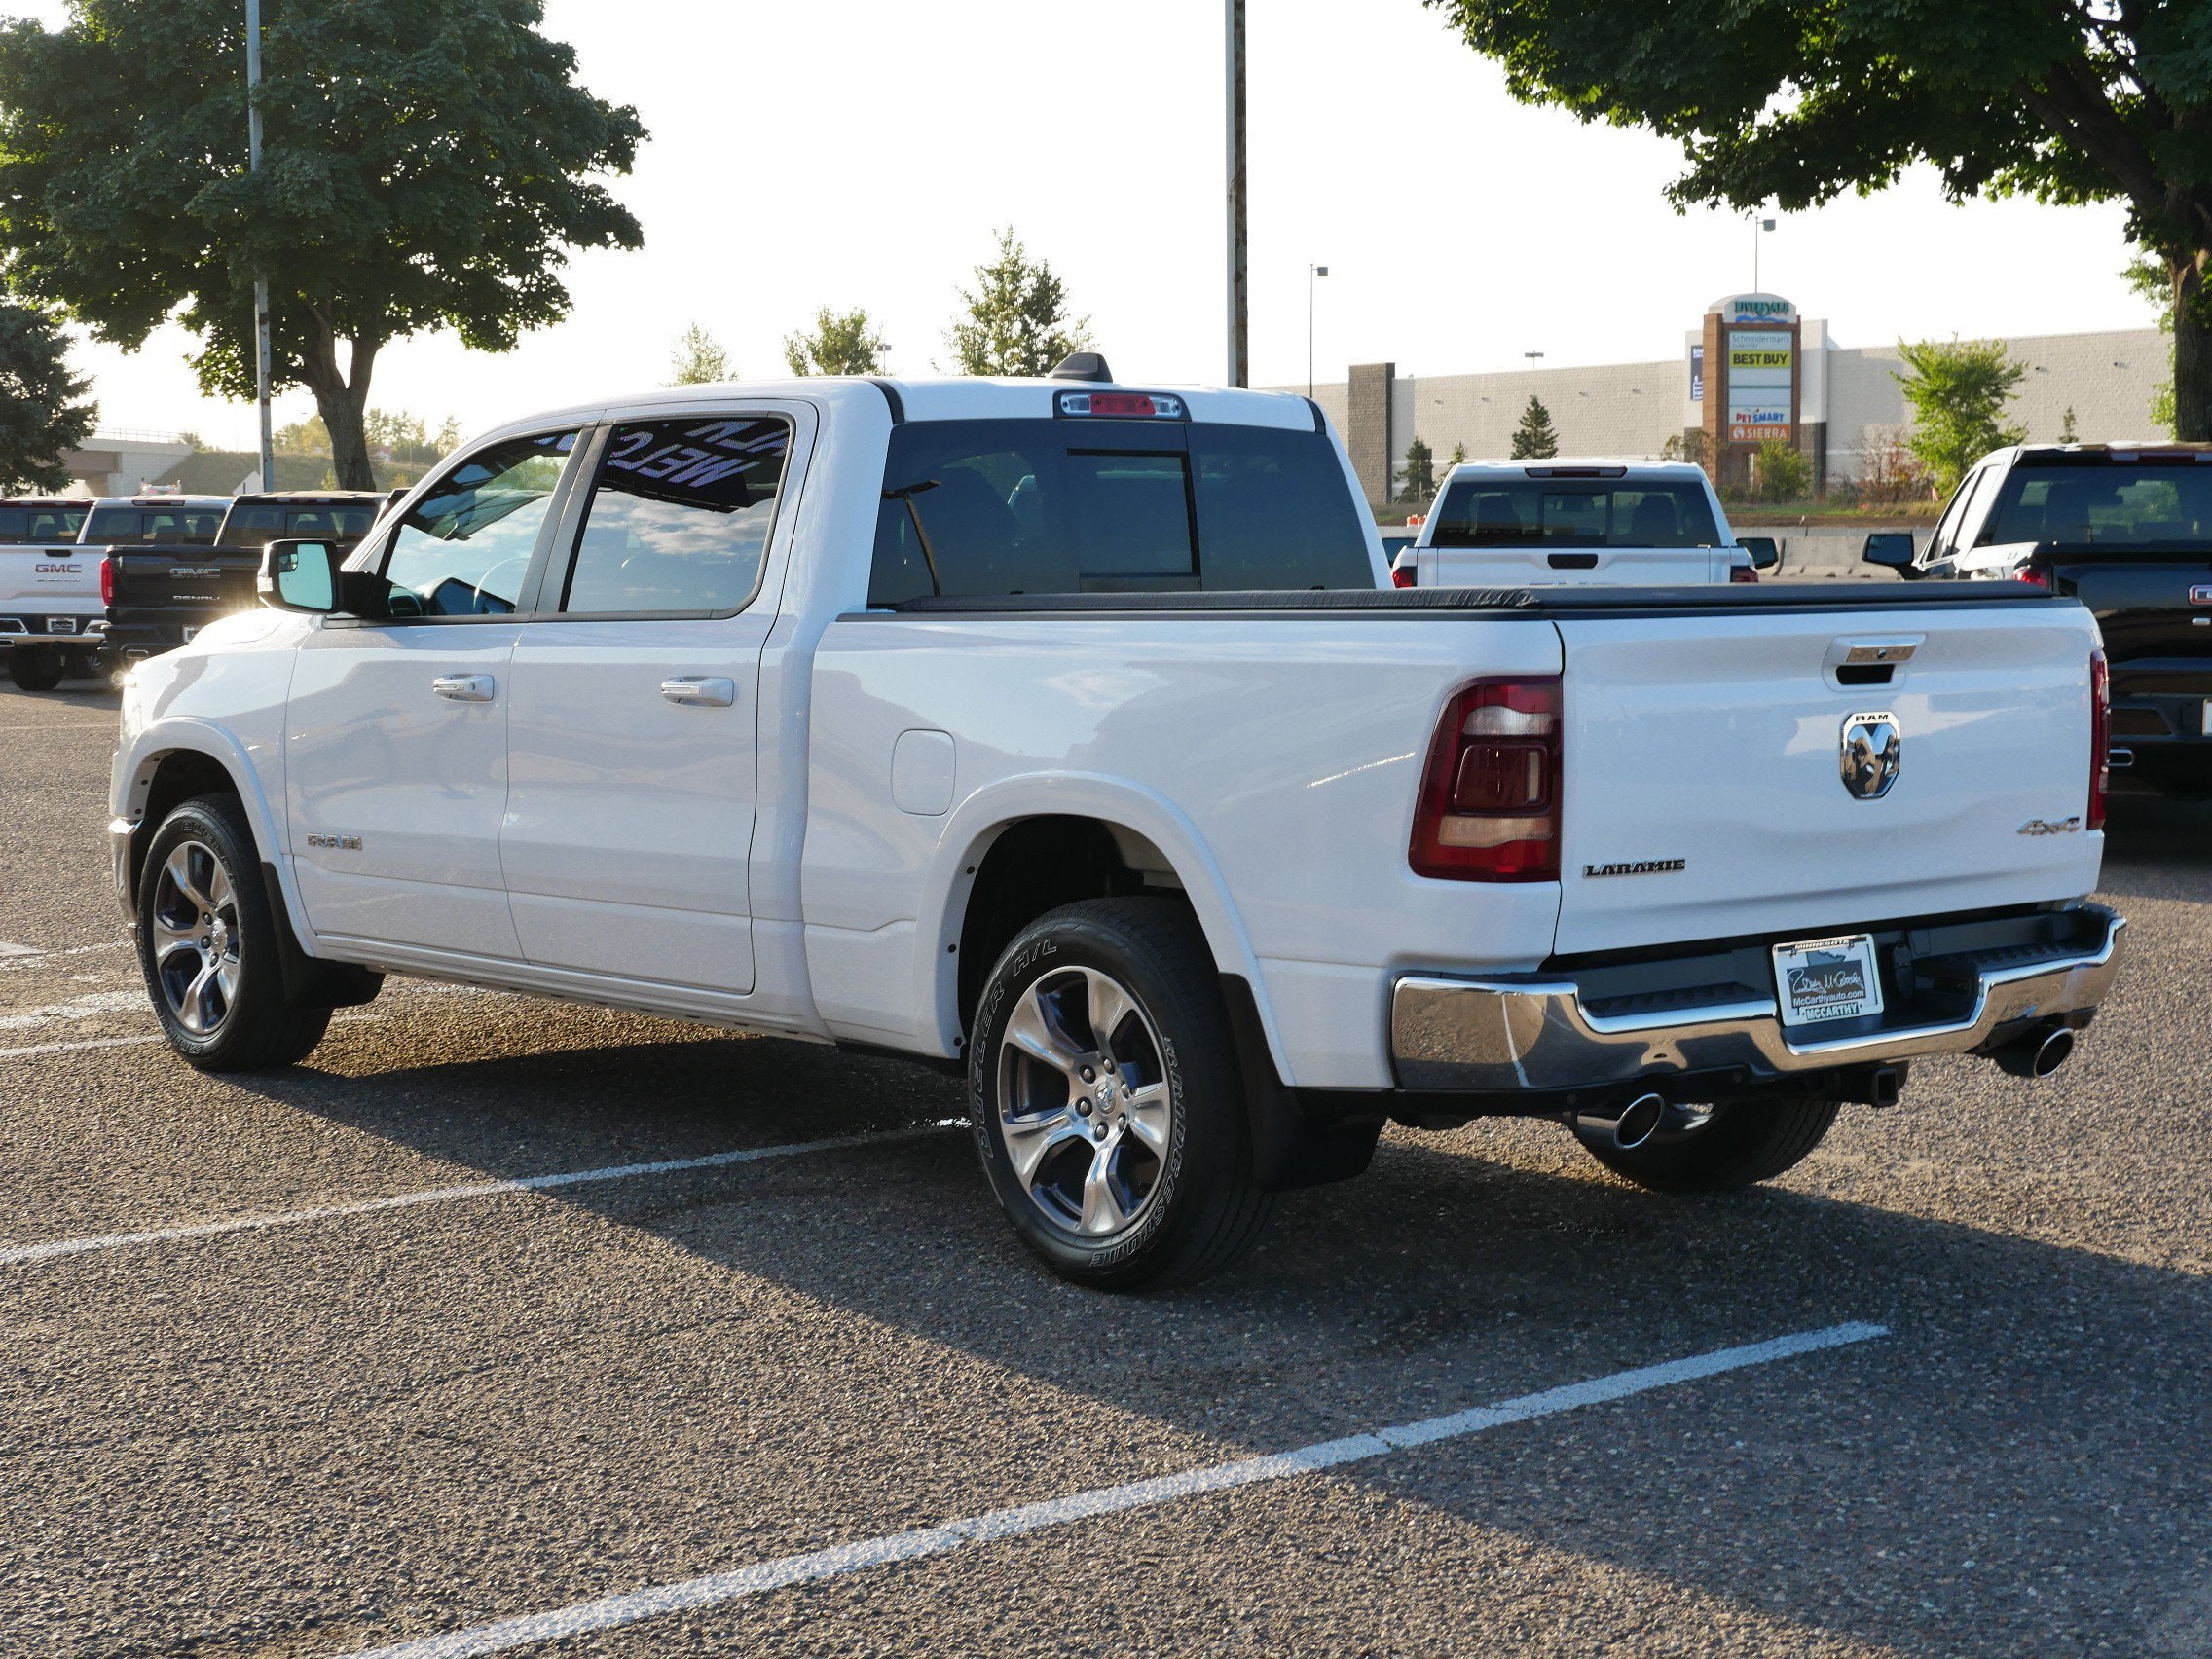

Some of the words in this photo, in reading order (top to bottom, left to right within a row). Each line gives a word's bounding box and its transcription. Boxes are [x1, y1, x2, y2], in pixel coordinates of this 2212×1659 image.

[1733, 353, 1762, 365] BEST
[1763, 353, 1788, 365] BUY
[1746, 428, 1788, 439] SIERRA
[35, 564, 83, 573] GMC
[169, 568, 221, 579] GMC
[1855, 714, 1889, 722] RAM
[1583, 859, 1686, 878] LARAMIE
[1806, 1002, 1859, 1020] MCCARTHY
